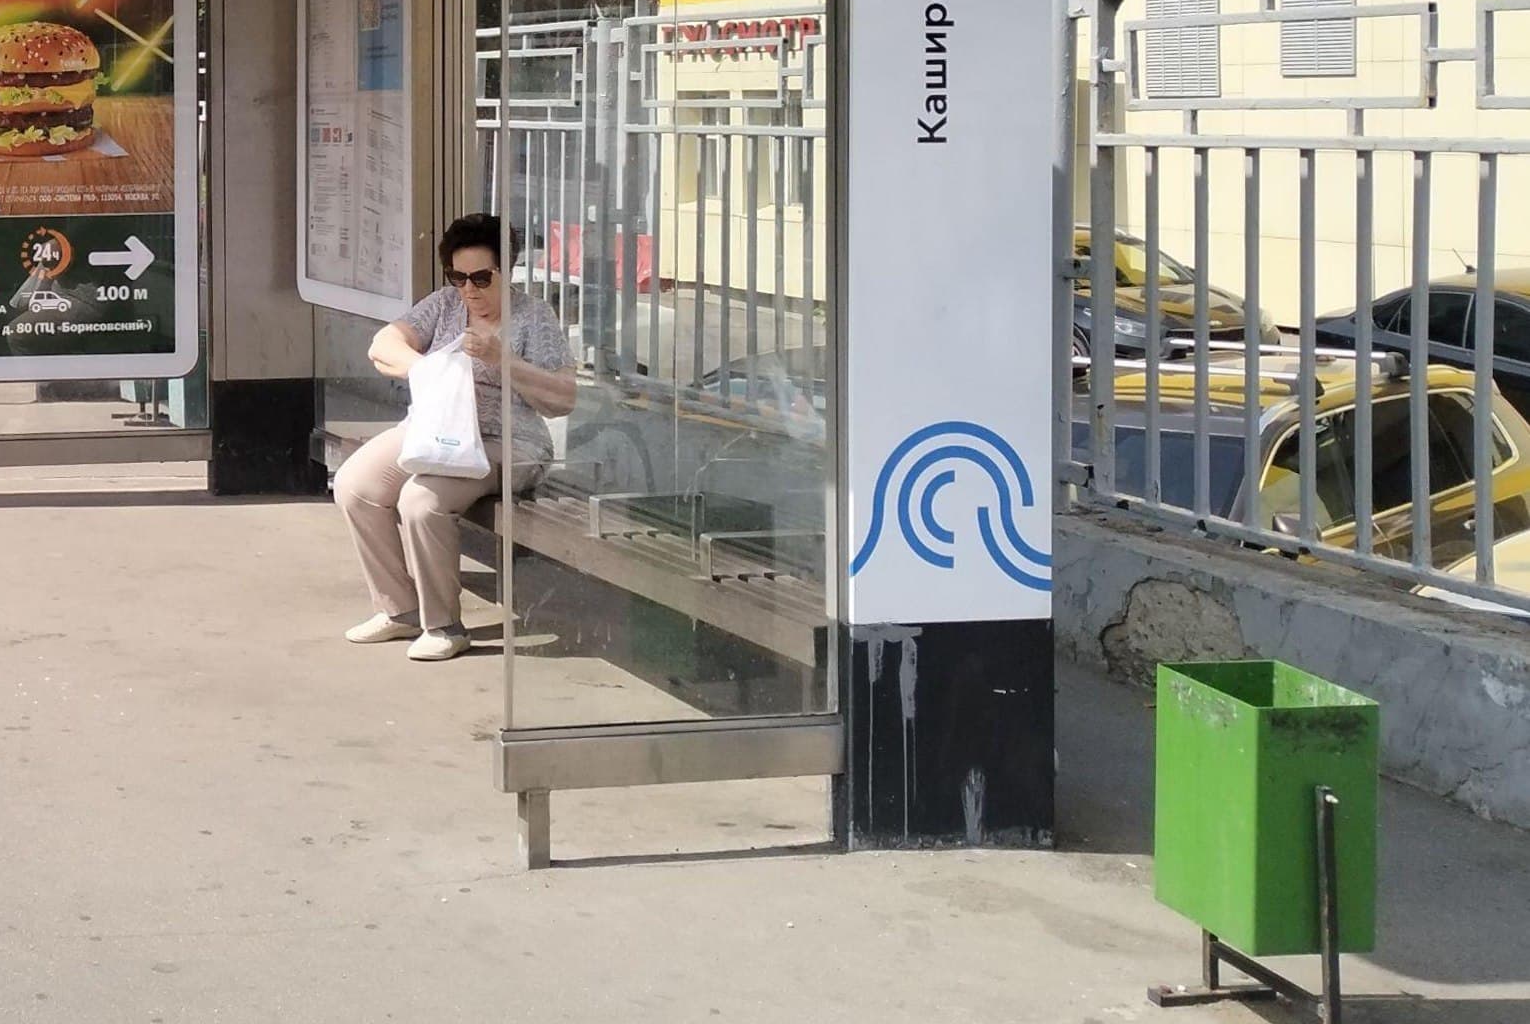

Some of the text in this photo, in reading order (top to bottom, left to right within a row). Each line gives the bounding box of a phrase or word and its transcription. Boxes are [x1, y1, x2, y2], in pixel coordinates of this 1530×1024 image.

[96, 286, 148, 301] 100 м
[2, 326, 14, 336] д.
[16, 322, 33, 334] 80
[34, 321, 55, 335] (ТЦ
